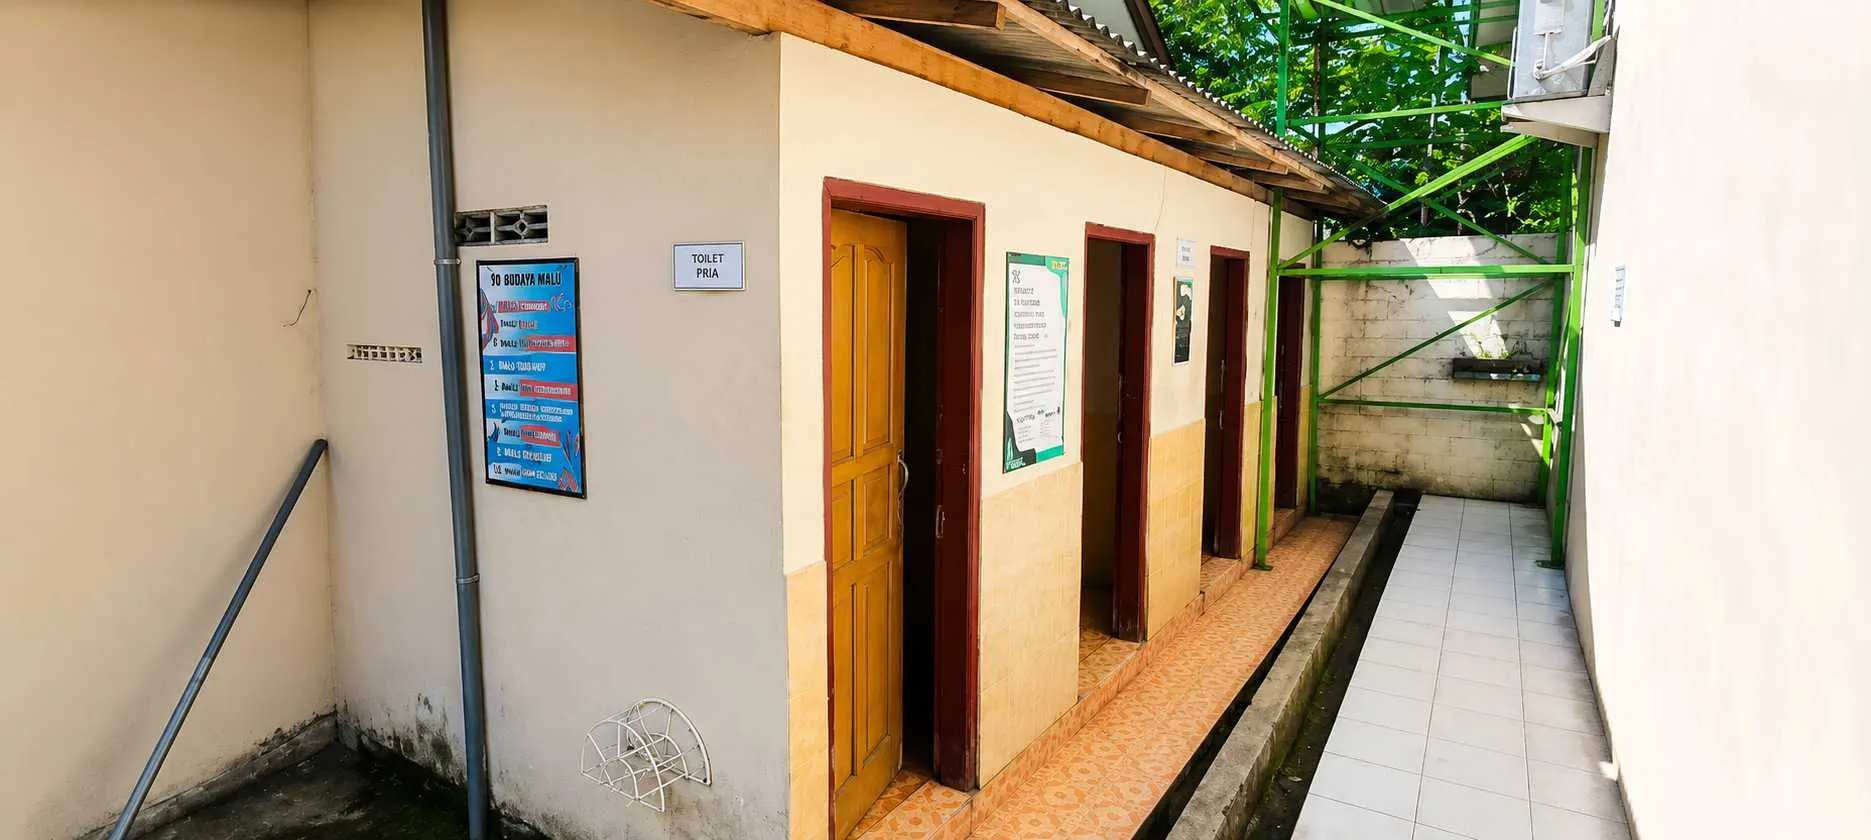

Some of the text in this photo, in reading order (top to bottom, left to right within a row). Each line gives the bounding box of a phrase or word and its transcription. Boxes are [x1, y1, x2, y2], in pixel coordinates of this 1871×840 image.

[692, 253, 724, 264] TOILET
[696, 267, 719, 279] PRIA
[504, 273, 535, 287] BUDAYA
[537, 272, 561, 286] MALU
